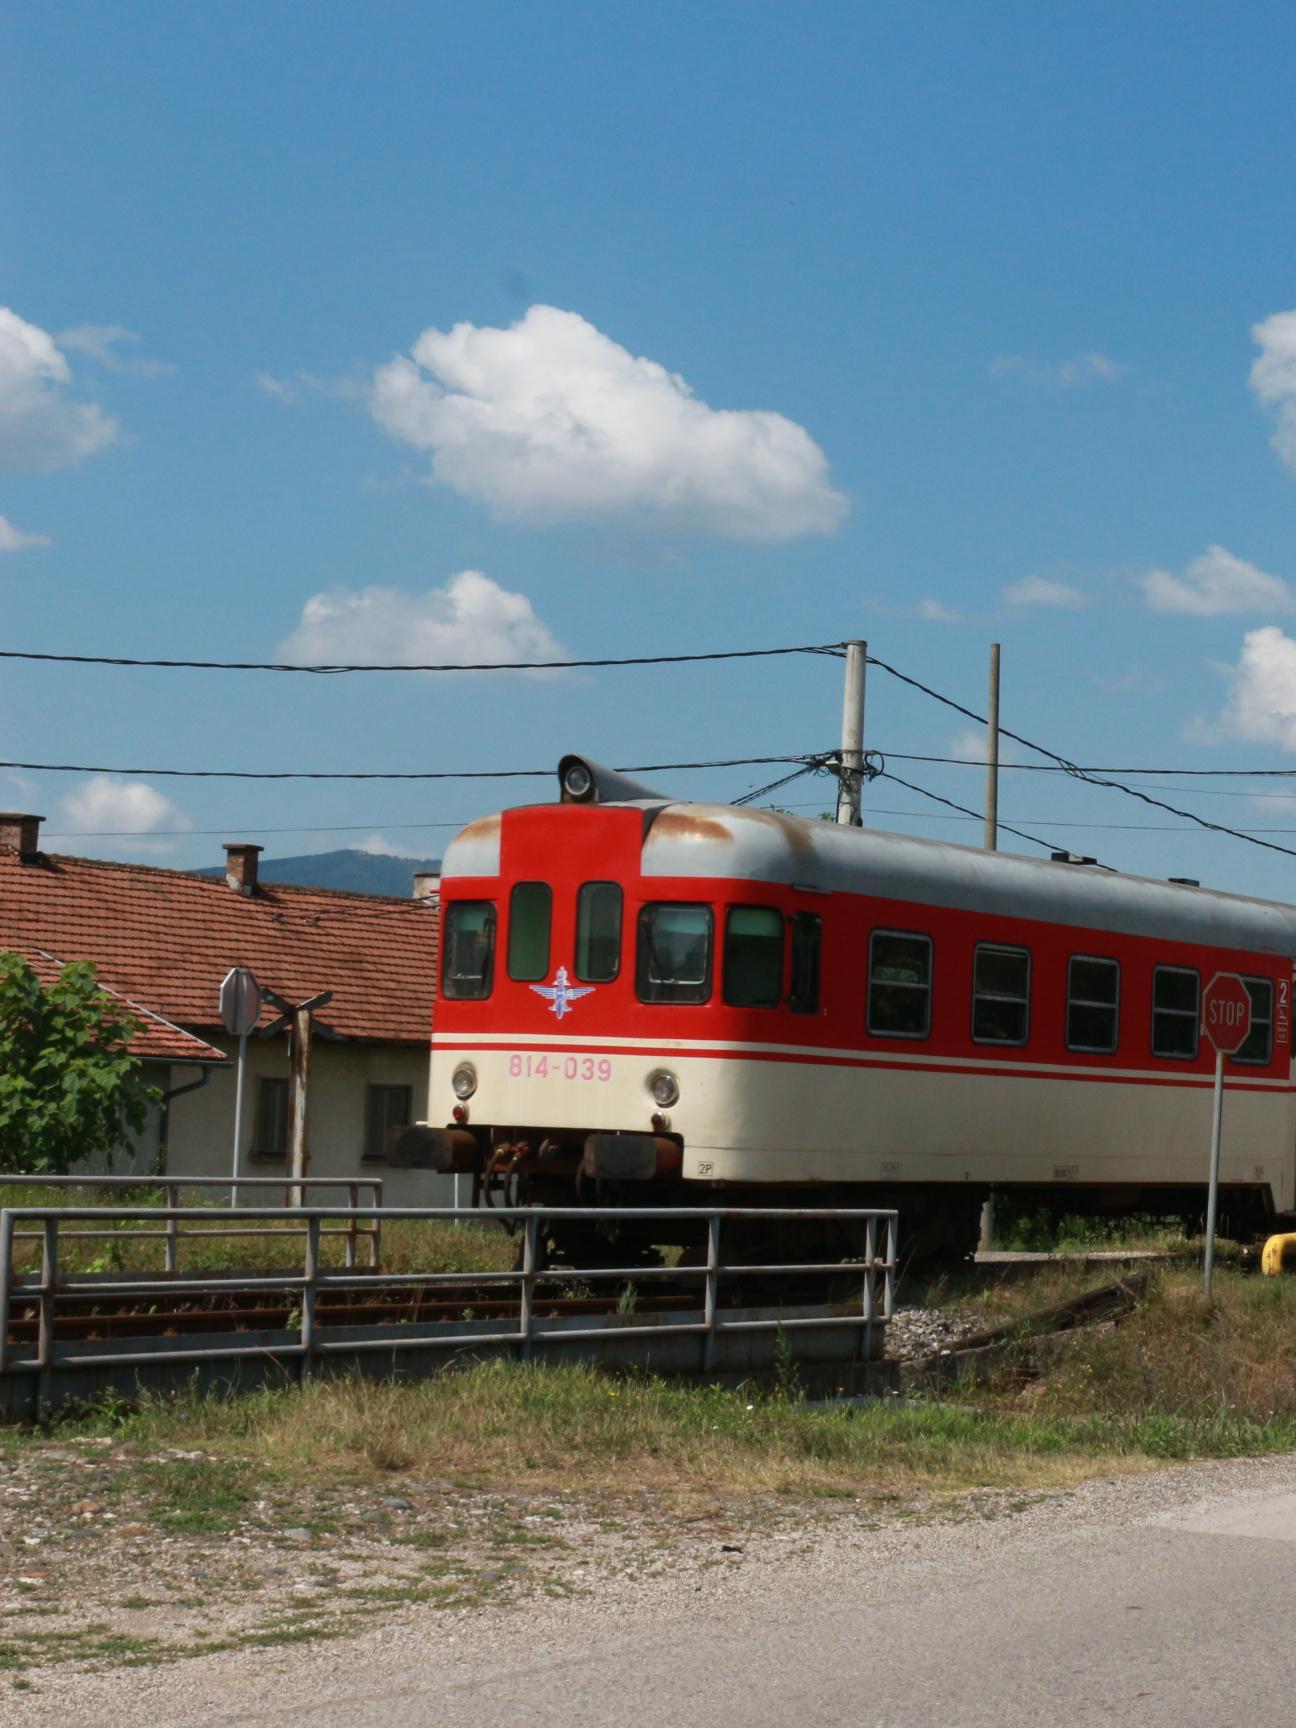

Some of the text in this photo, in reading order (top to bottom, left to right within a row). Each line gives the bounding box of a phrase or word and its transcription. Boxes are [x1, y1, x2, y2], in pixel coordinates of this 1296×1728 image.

[1279, 982, 1288, 1005] 2
[1210, 1000, 1245, 1026] STOP
[509, 1054, 612, 1082] 814-039
[698, 1163, 712, 1175] 2P
